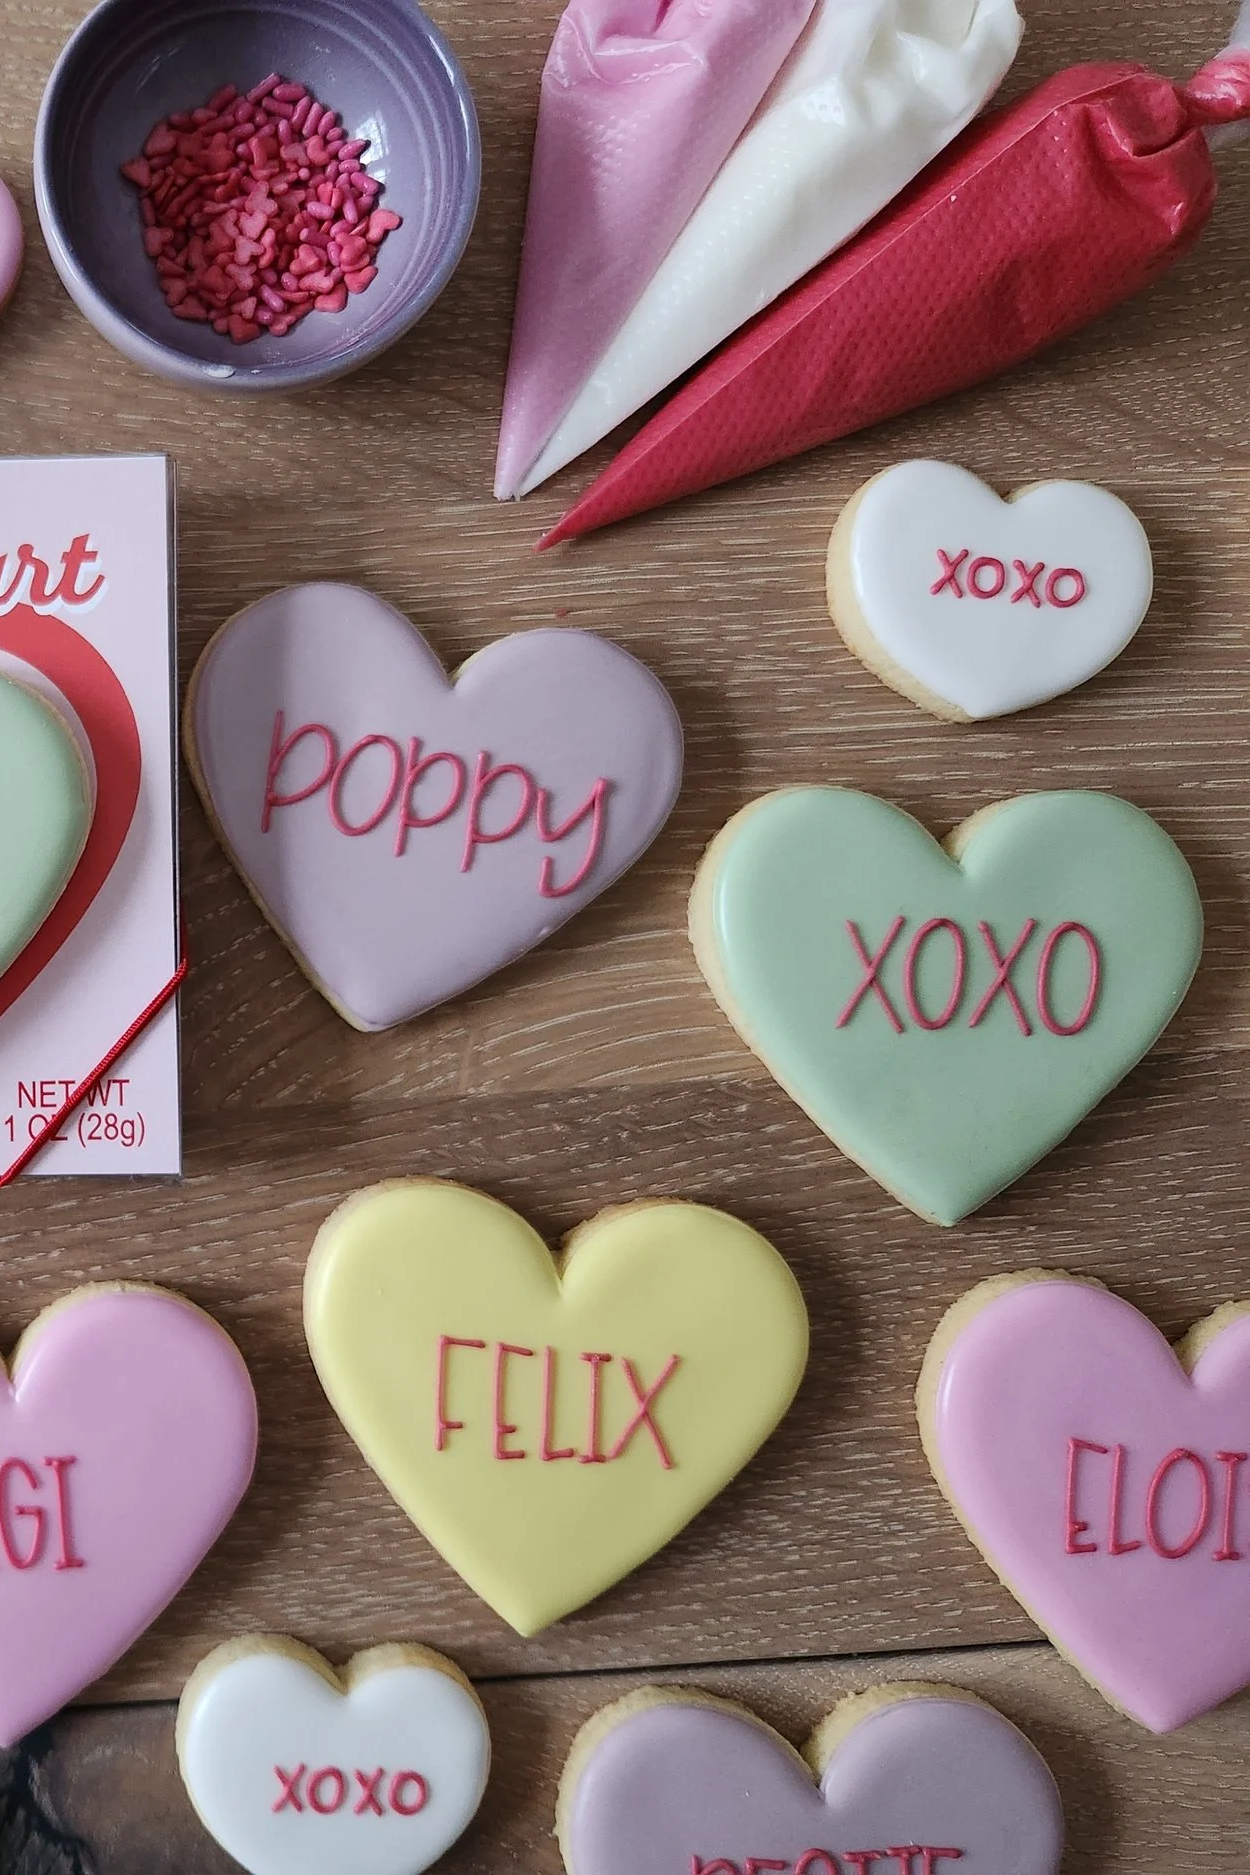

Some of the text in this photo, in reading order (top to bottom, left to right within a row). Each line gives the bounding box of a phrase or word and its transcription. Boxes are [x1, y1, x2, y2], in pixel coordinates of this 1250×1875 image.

[834, 914, 1103, 1038] XOXO
[4, 1114, 14, 1142] 1
[77, 1111, 146, 1149] (28g)
[17, 1079, 130, 1108] NET WT
[434, 1334, 682, 1471] FELIX
